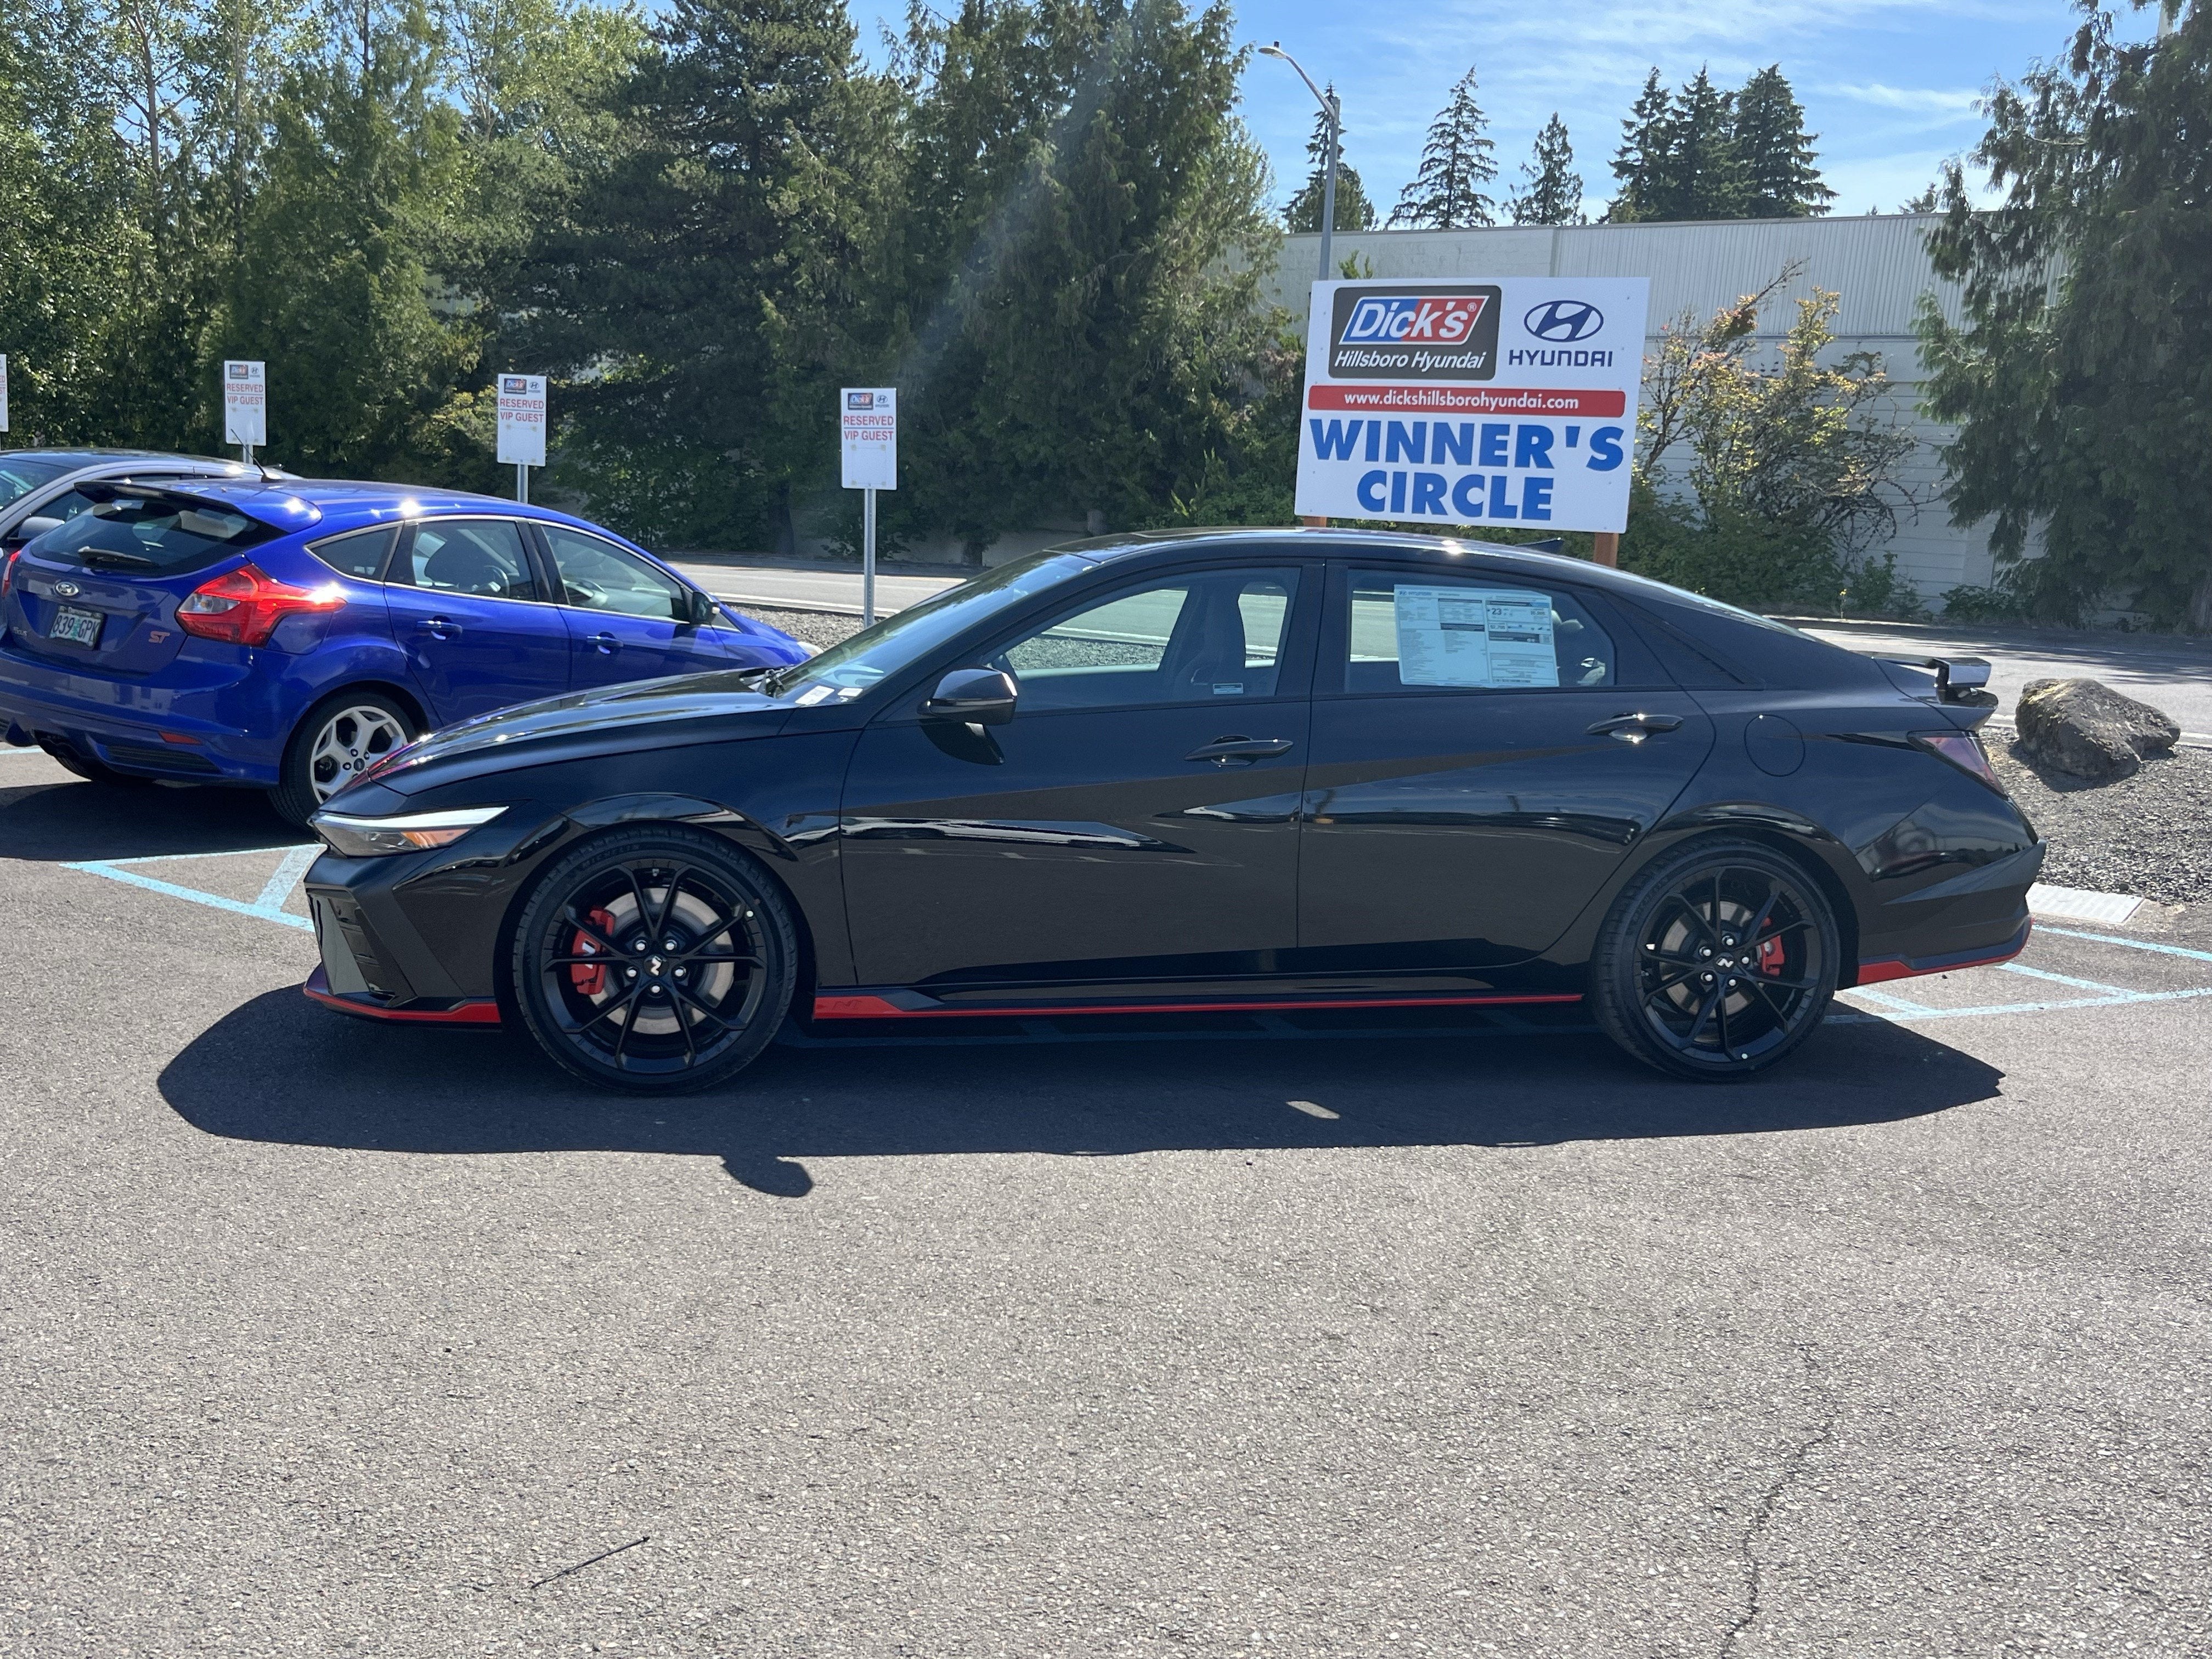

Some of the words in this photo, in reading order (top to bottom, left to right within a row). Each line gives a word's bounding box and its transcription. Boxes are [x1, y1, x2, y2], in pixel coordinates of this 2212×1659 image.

[1350, 301, 1469, 338] Dick's
[1334, 350, 1409, 368] Hillsboro
[1410, 351, 1487, 373] Hyundai
[1509, 349, 1613, 368] HYUNDAI
[227, 384, 264, 393] RESERVED
[227, 396, 238, 404] VIP
[240, 396, 264, 405] GUEST
[500, 398, 544, 409] RESERVED
[1344, 390, 1579, 411] www.dickshillsborohyundai.com
[500, 411, 514, 421] VIP
[515, 412, 544, 422] GUEST
[843, 415, 894, 426] RESERVED
[844, 431, 859, 441] VIP
[861, 431, 894, 441] GUEST
[1310, 419, 1624, 472] WINNER'S
[1357, 470, 1554, 521] CIRCLE
[53, 615, 75, 635] 839
[149, 630, 171, 644] ST
